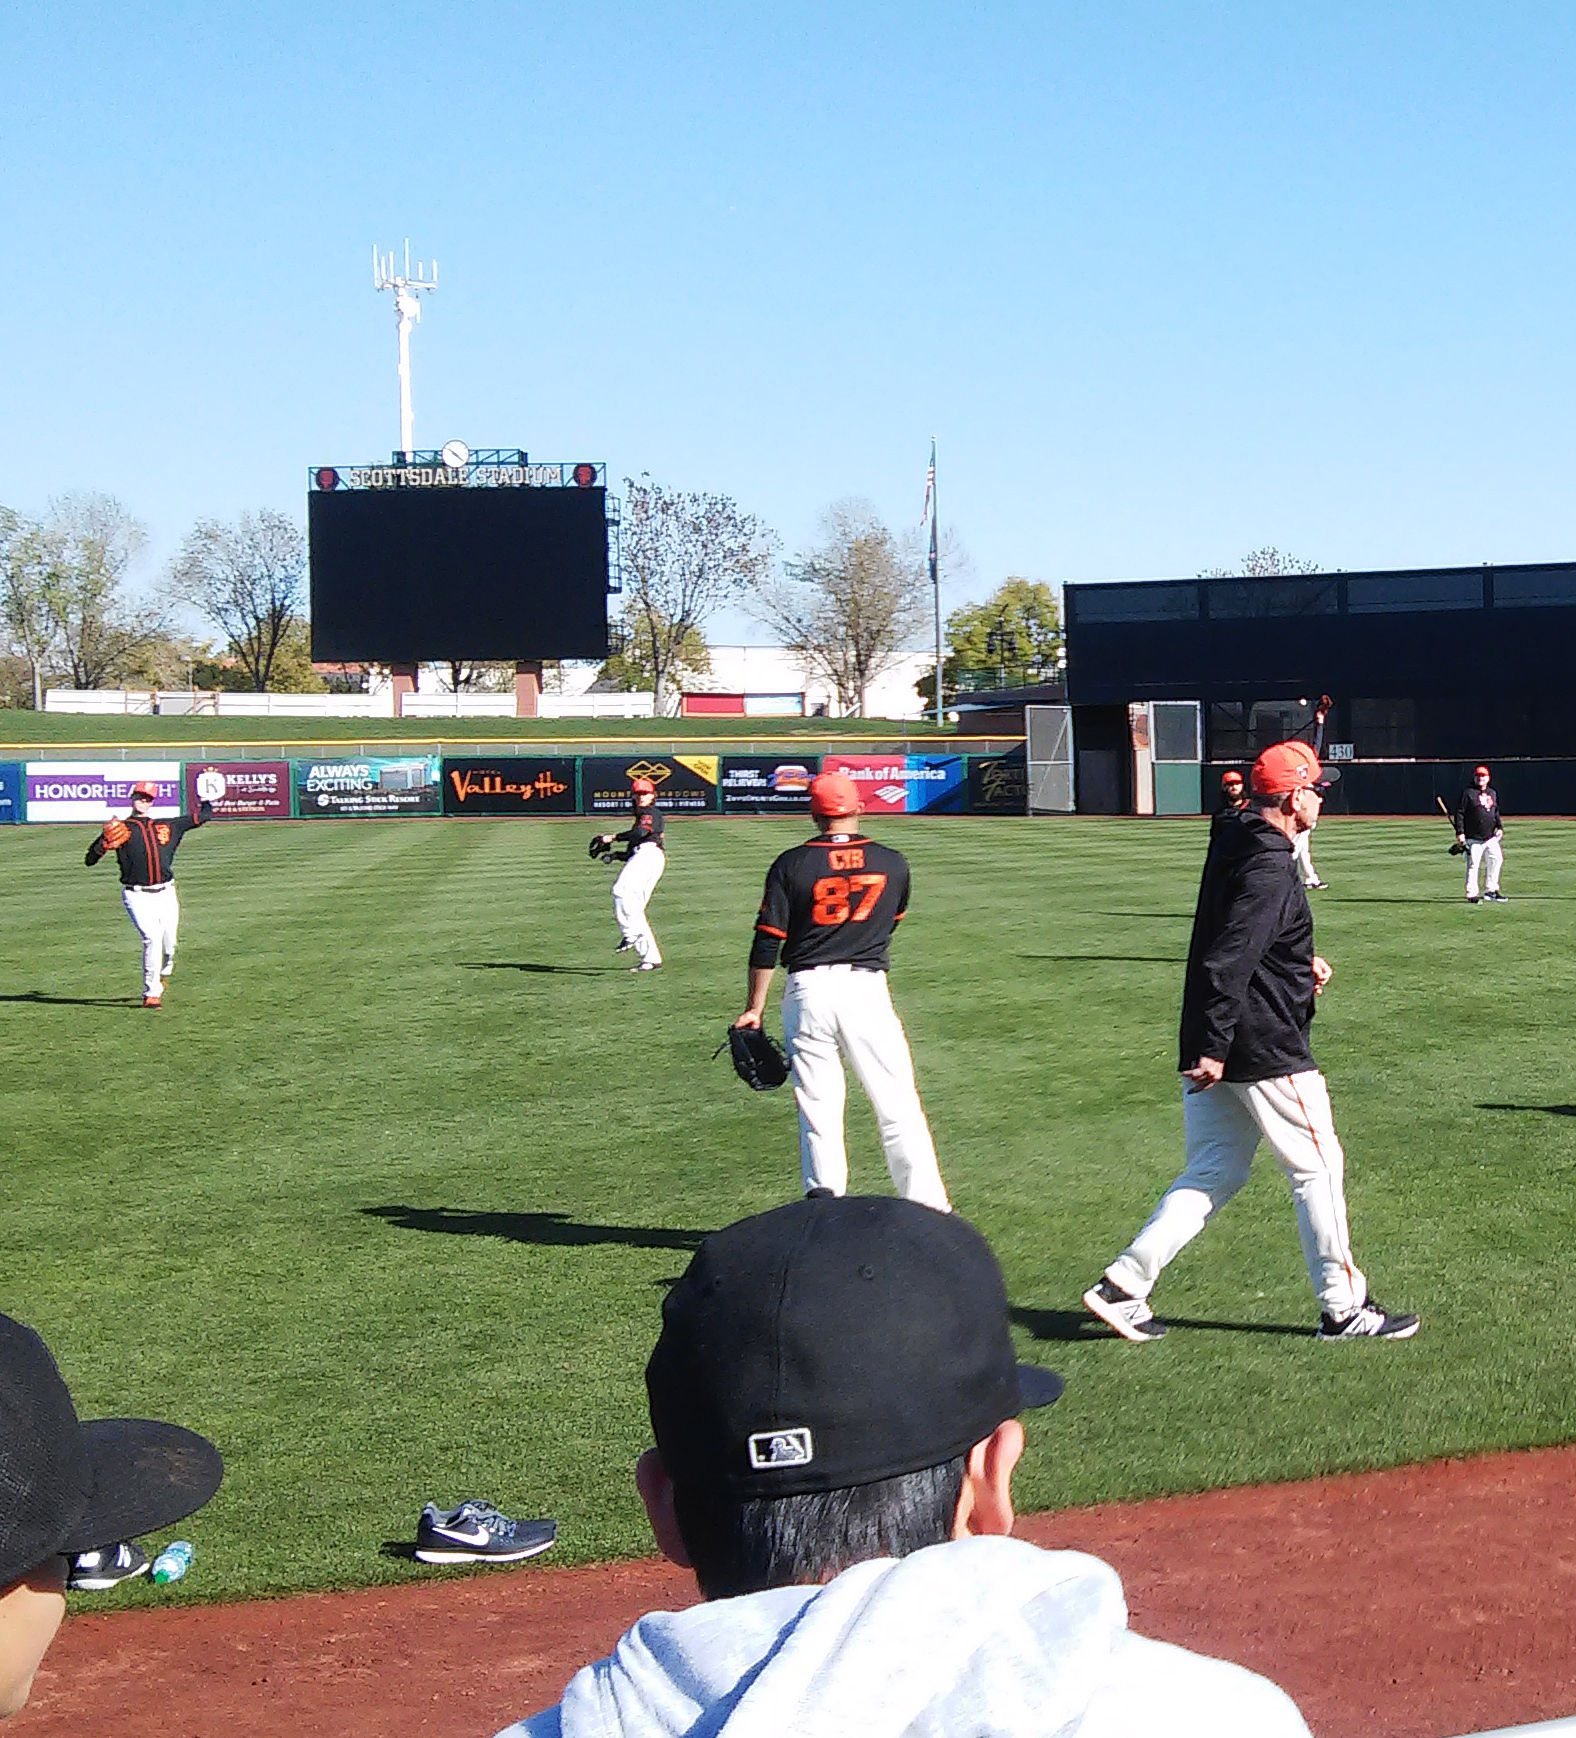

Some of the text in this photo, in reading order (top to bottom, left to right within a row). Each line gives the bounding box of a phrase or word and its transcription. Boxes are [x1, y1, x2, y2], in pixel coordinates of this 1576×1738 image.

[350, 467, 562, 486] SCOTTSDALE STADIUM
[1329, 745, 1352, 758] 430
[309, 765, 369, 778] ALWAYS
[728, 770, 760, 778] THIRST
[839, 766, 946, 780] Bank of America
[226, 773, 277, 784] KELLY'S
[305, 778, 373, 791] EXCITING
[450, 770, 567, 802] Valley Ho
[828, 849, 866, 871] CYR
[812, 873, 888, 926] 87
